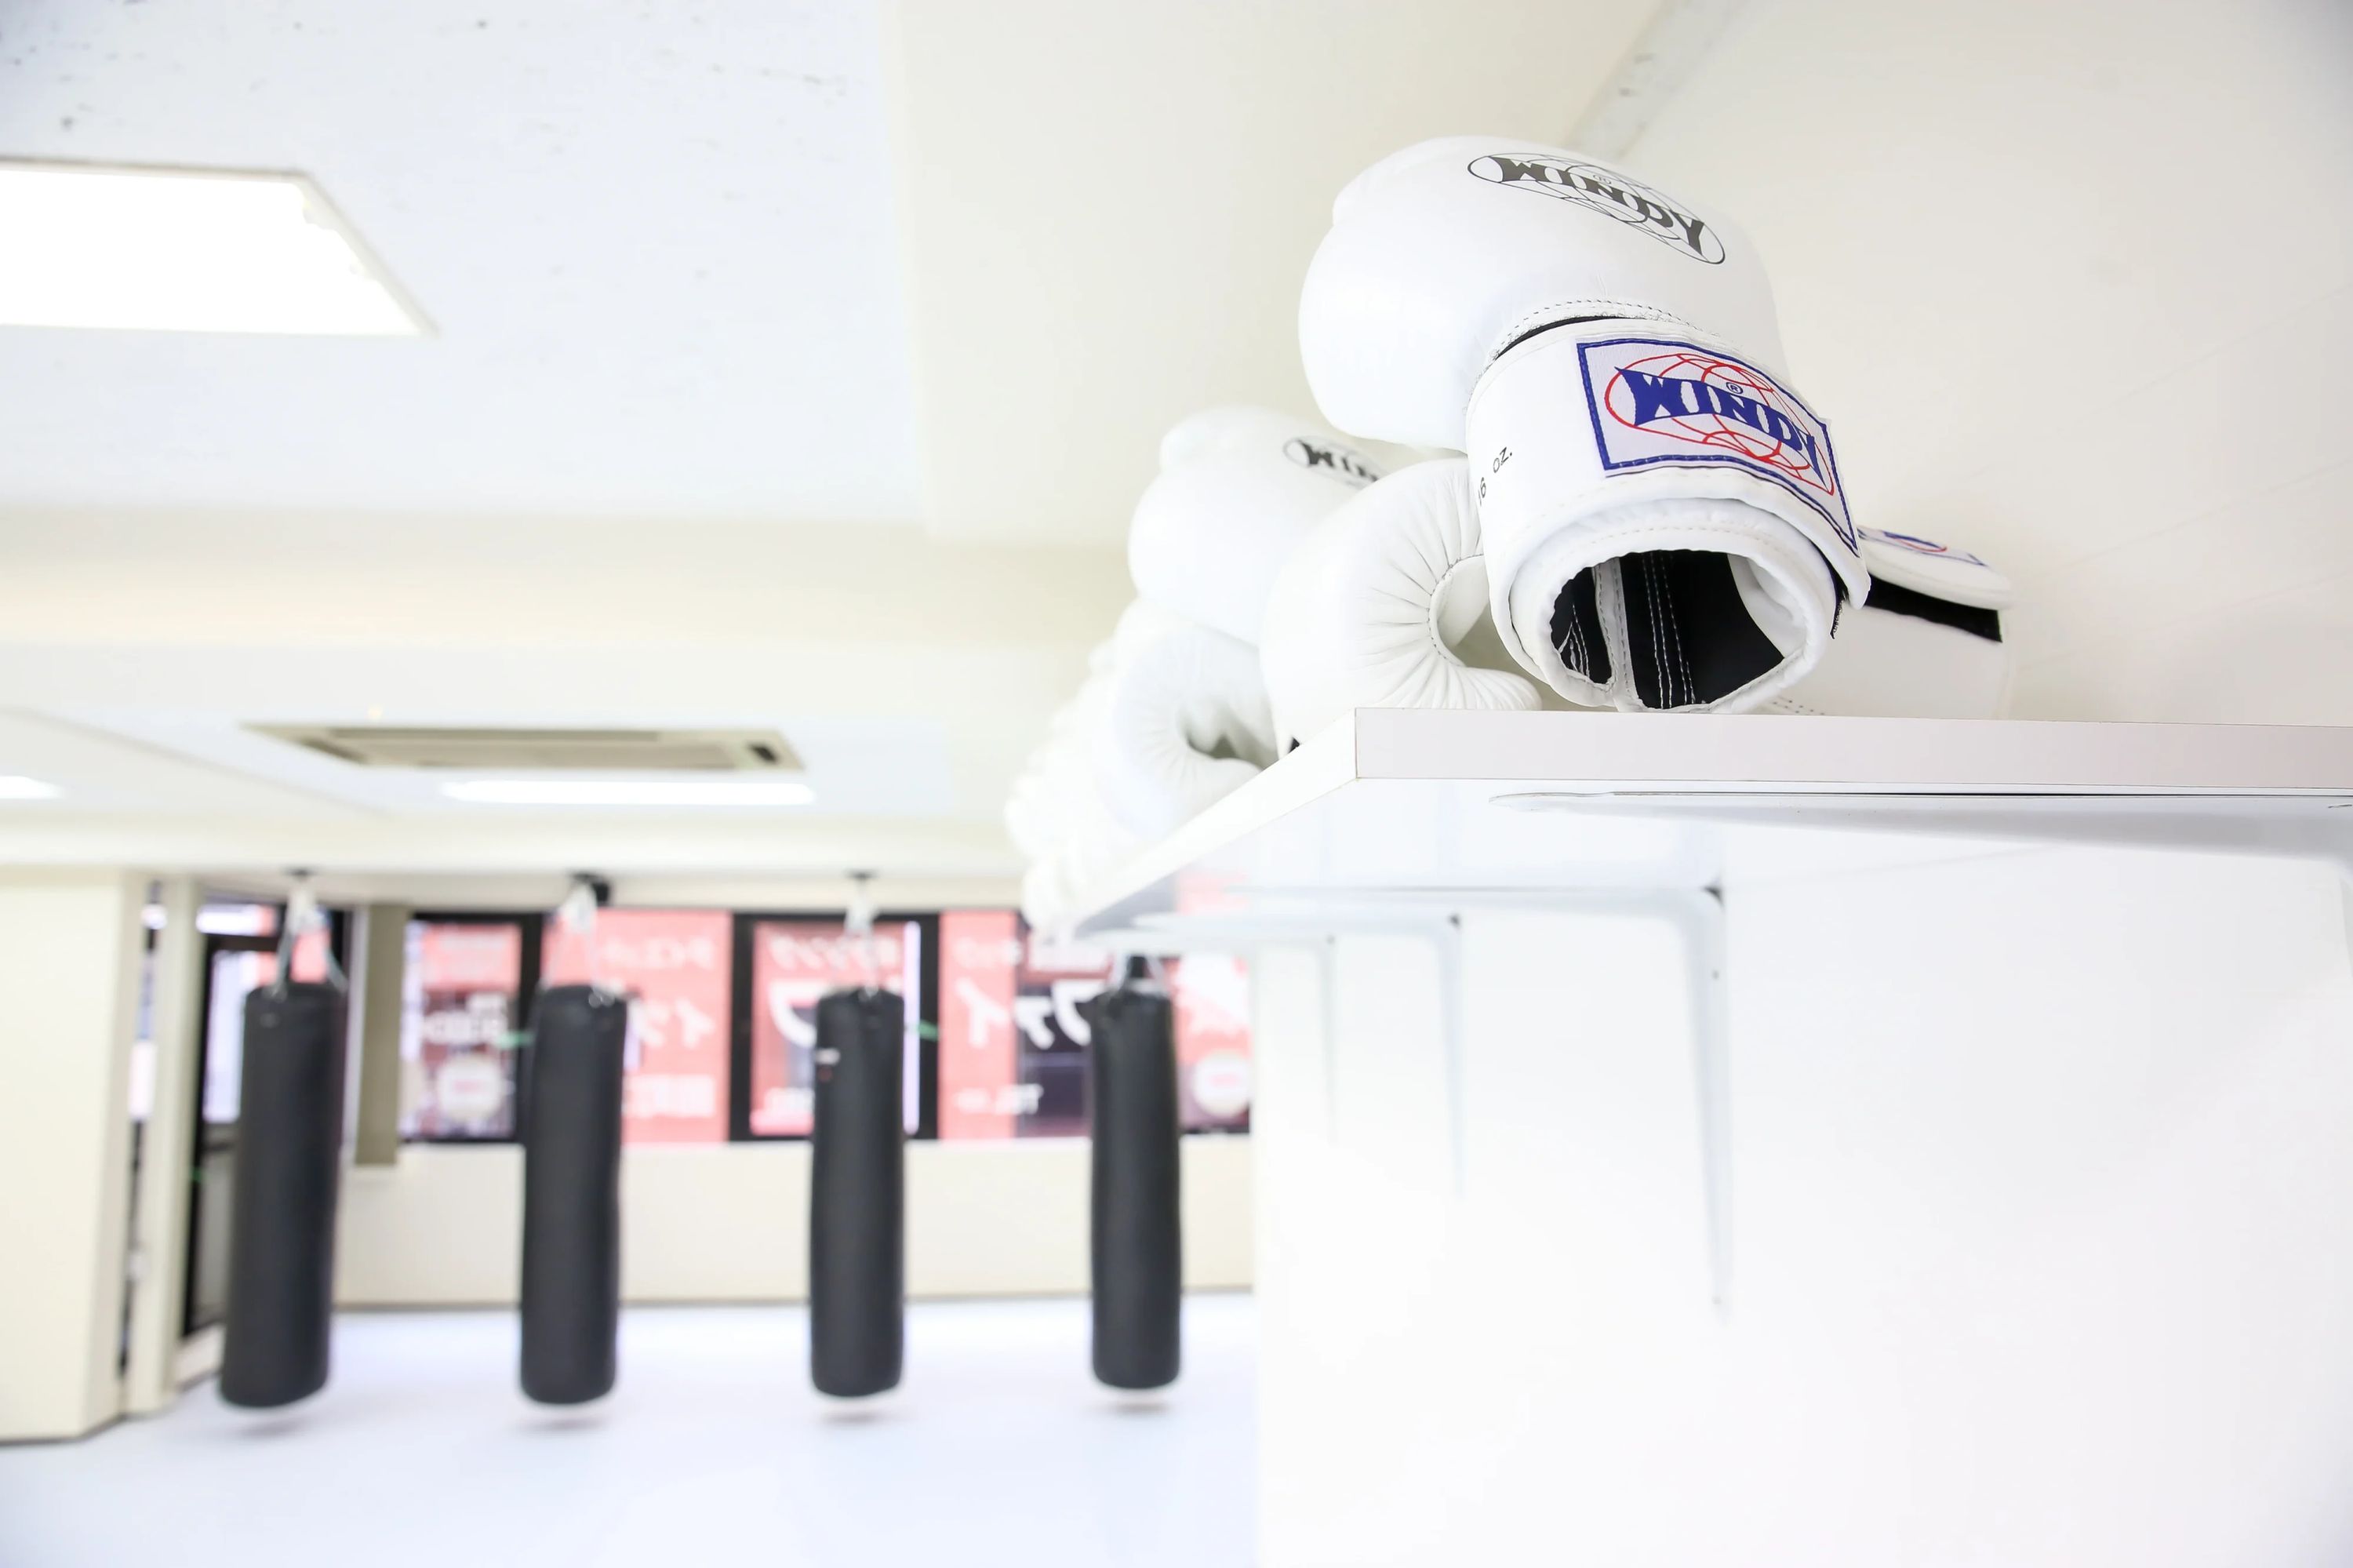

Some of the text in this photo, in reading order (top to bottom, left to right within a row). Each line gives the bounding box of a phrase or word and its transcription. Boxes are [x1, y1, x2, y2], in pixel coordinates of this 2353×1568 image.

[1488, 155, 1705, 256] WINDY
[1296, 438, 1380, 483] WIN
[1613, 366, 1830, 493] WINDY
